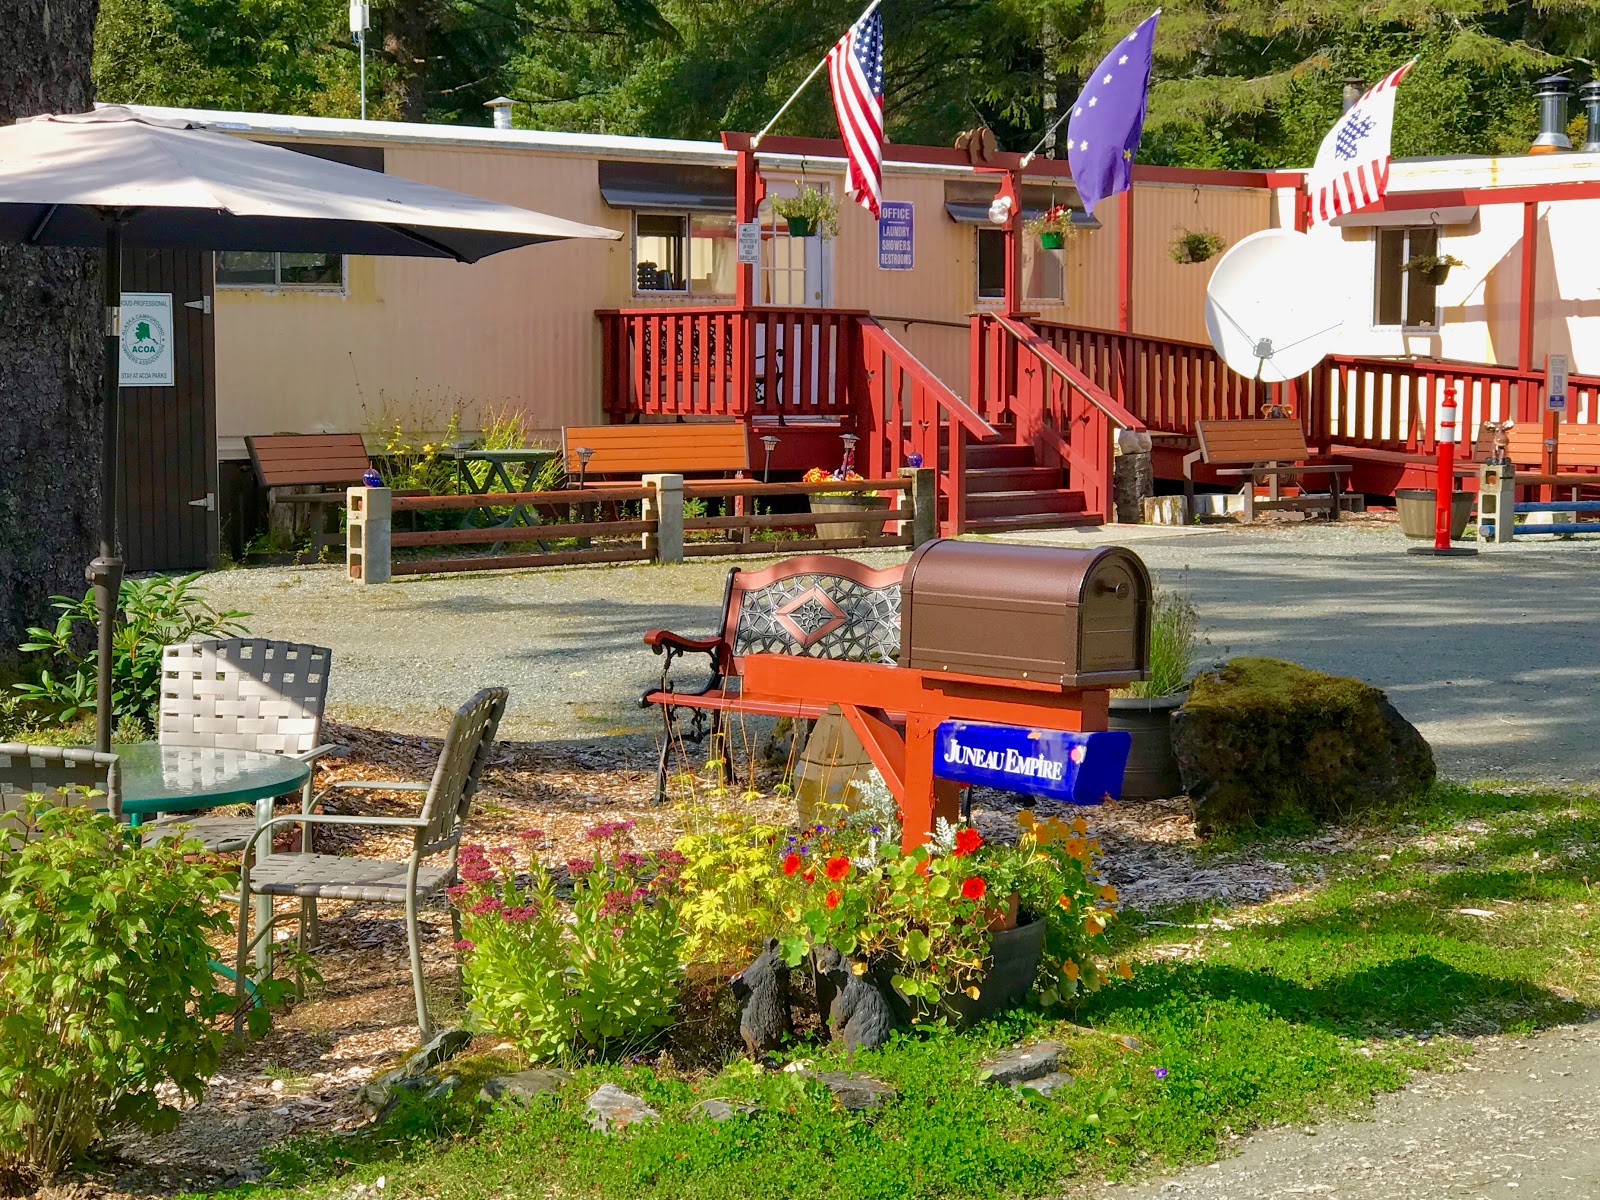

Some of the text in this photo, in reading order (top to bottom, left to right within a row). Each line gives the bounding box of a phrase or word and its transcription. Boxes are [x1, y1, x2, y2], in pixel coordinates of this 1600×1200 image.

[882, 208, 910, 219] OFFICE
[882, 225, 910, 237] LAUNDRY
[881, 239, 911, 251] SHOWERS
[880, 253, 912, 265] RESTROOMS
[122, 316, 135, 336] ALASKA
[132, 345, 156, 353] ACOA
[138, 344, 165, 366] ASSOCIATION
[944, 738, 1063, 780] JUNEAU EMPIRE
